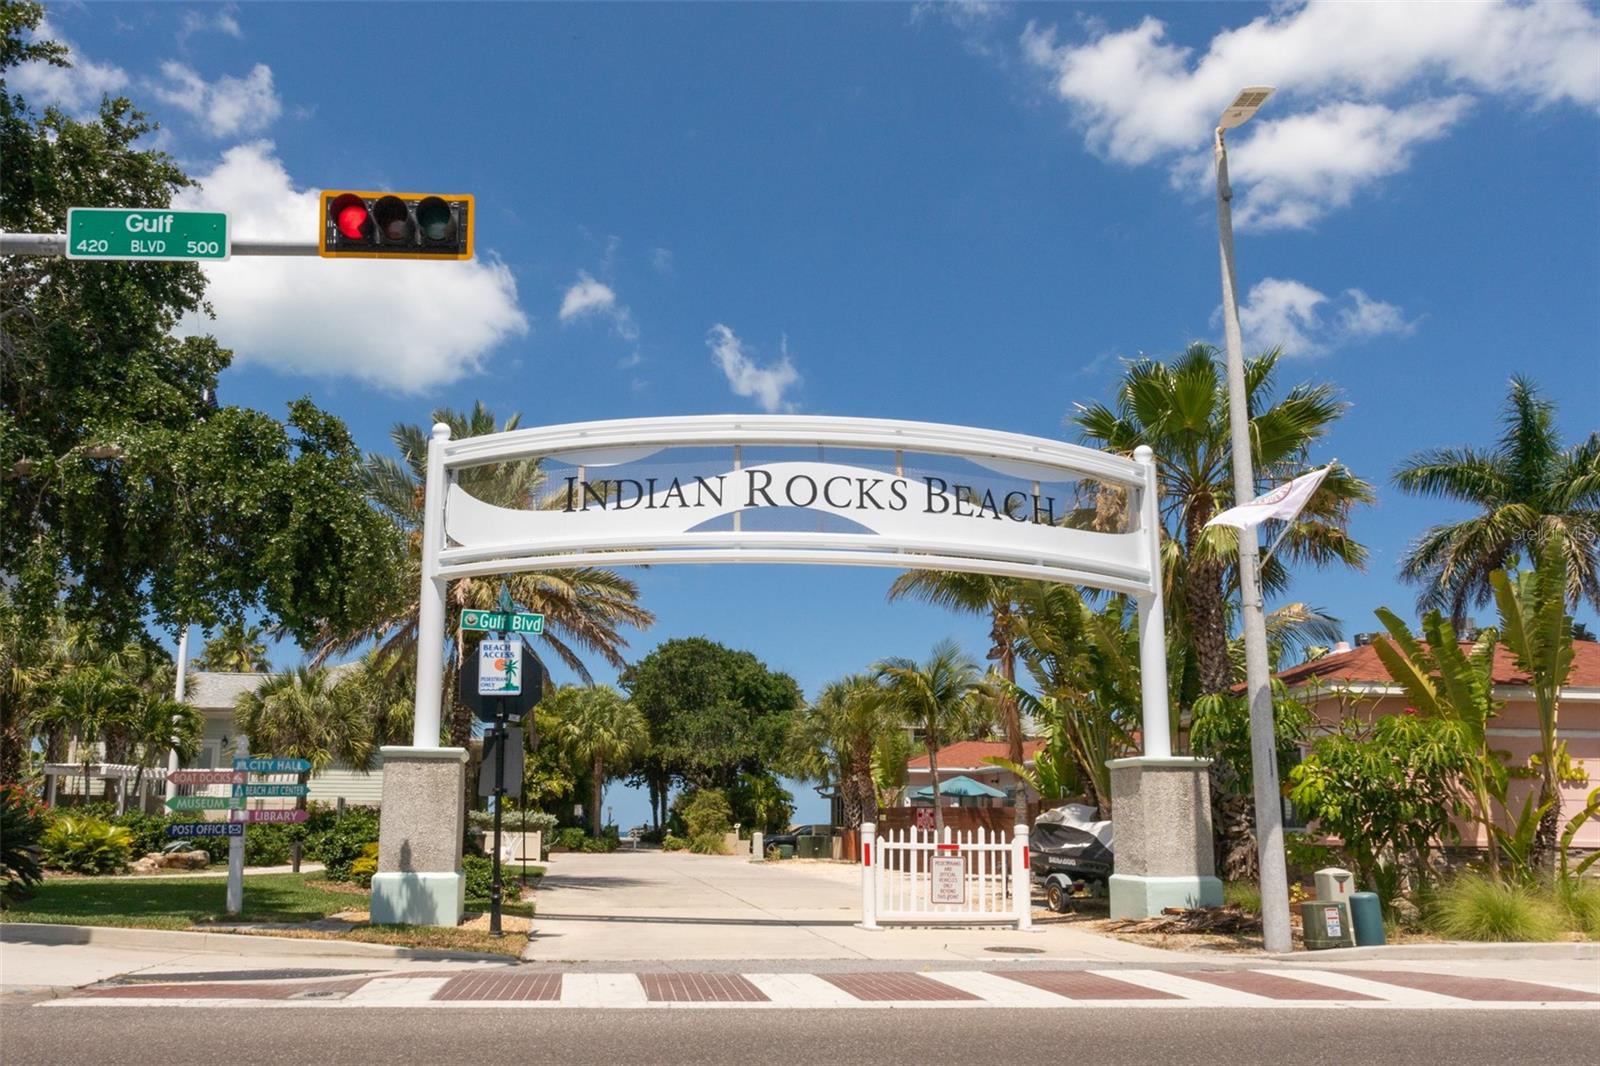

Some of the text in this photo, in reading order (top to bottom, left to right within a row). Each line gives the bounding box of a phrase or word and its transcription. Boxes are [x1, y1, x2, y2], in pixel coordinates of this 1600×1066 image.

[125, 213, 174, 233] Gulf
[76, 239, 219, 254] 420 BLVD 500
[562, 469, 1057, 527] INDIAN ROCKS BEACH
[480, 613, 542, 631] Gulf Blvd
[483, 651, 515, 659] ACCESS
[249, 760, 303, 770] CITY HALL
[174, 773, 231, 783] BOAT DOCKS
[246, 785, 304, 796] BEACH ART CENTER
[177, 798, 225, 809] MUSEUM
[254, 811, 298, 821] LIBRARY
[171, 824, 228, 835] POST OFFICE
